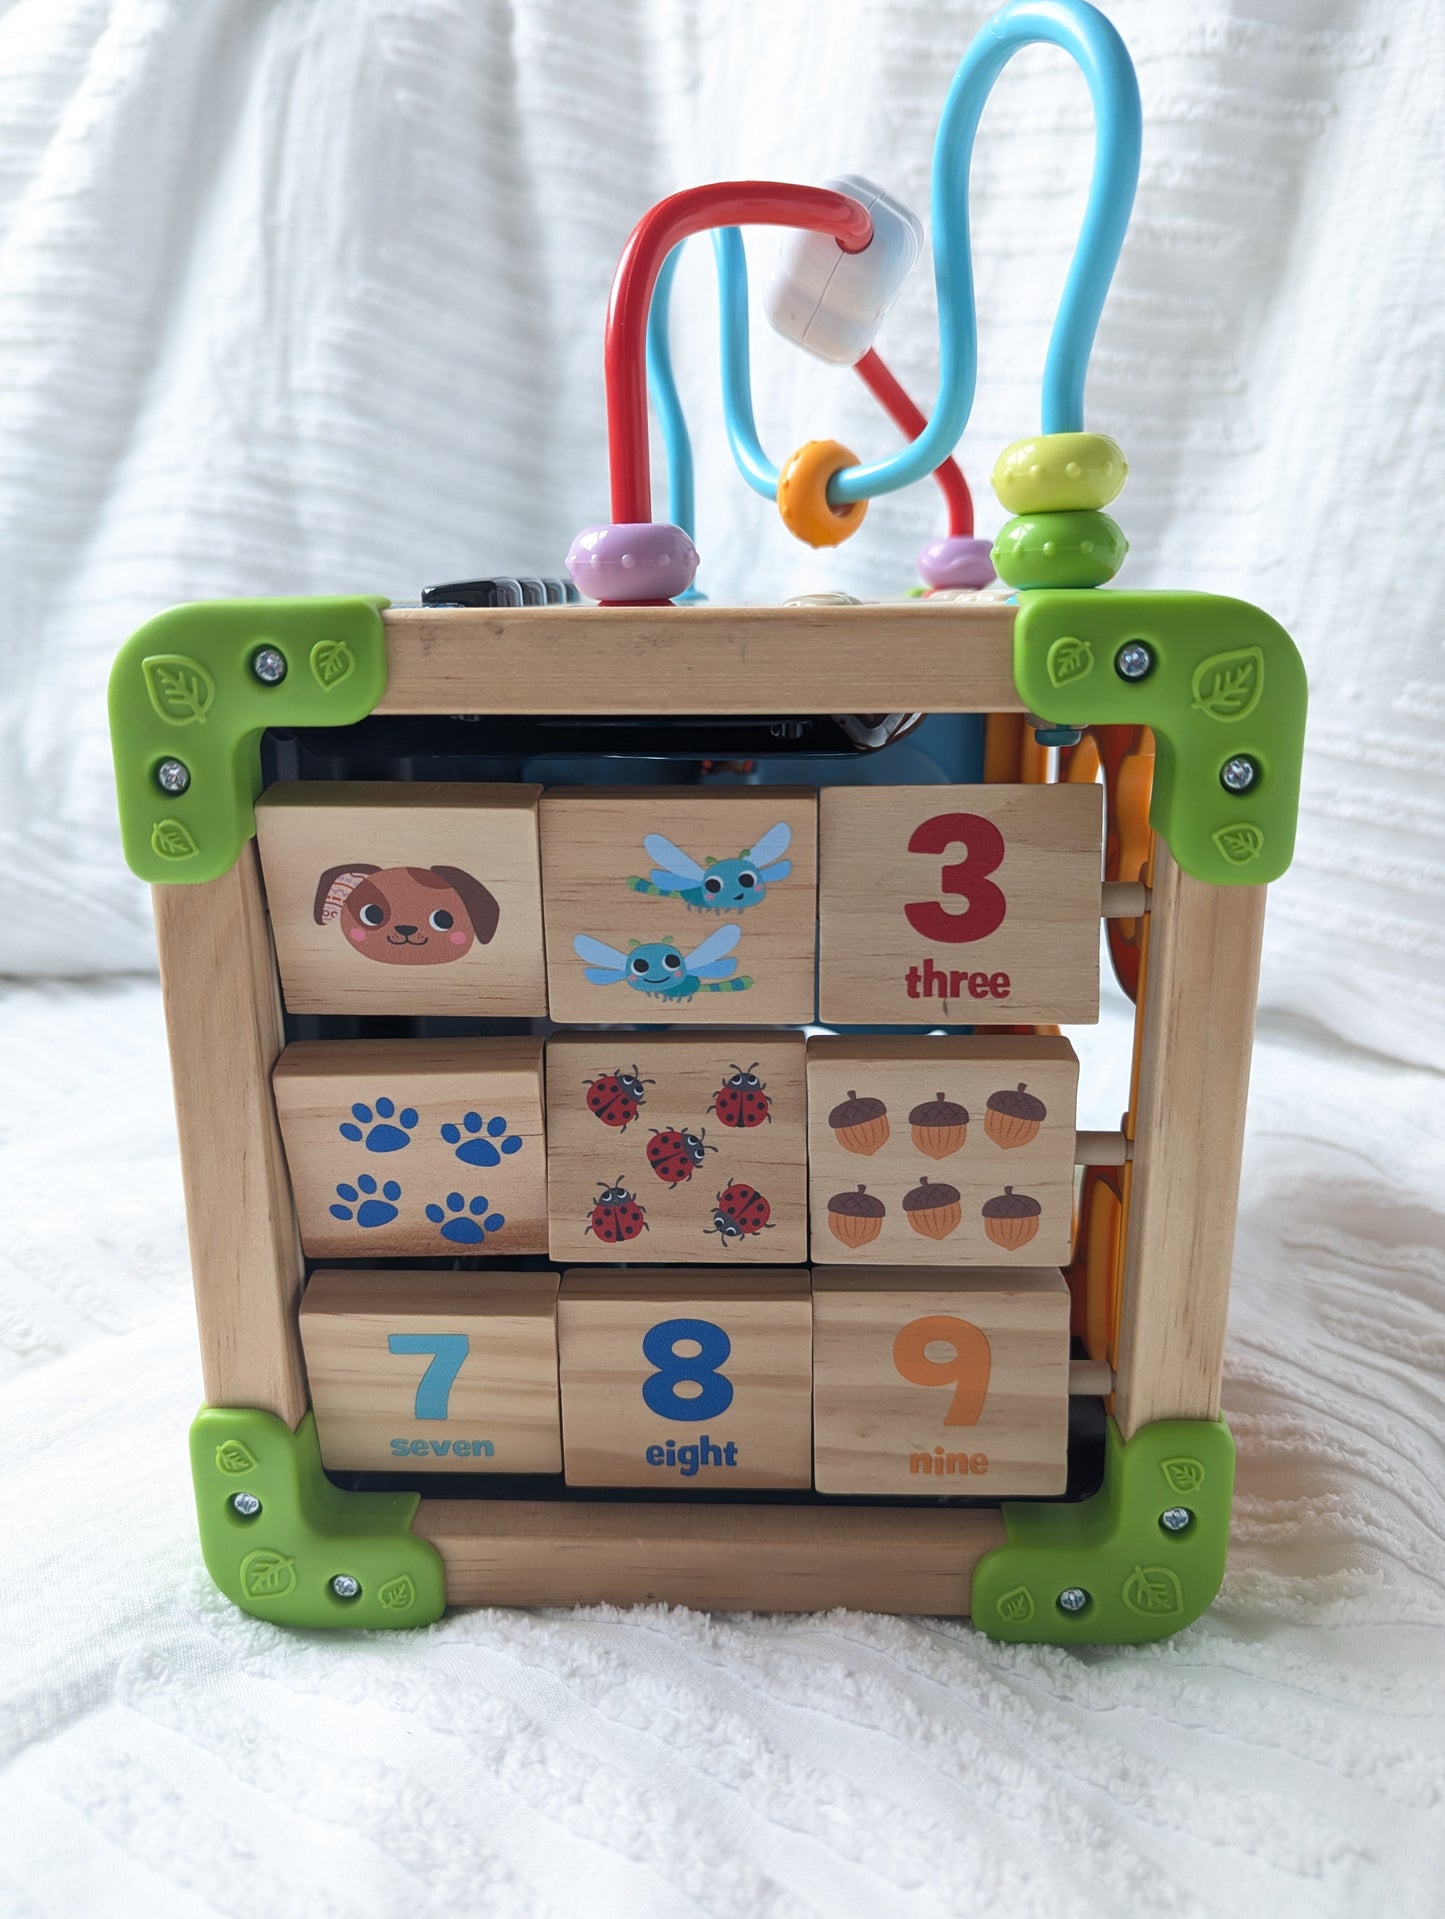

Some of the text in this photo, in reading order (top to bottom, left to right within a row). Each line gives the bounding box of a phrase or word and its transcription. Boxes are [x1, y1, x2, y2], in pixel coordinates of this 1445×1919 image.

[904, 812, 1007, 944] 3
[904, 958, 1011, 999] three
[387, 1333, 470, 1420] 7
[641, 1318, 734, 1422] 8
[892, 1315, 992, 1427] 9
[389, 1437, 495, 1458] seven
[645, 1435, 739, 1477] eight
[908, 1446, 990, 1476] nine
